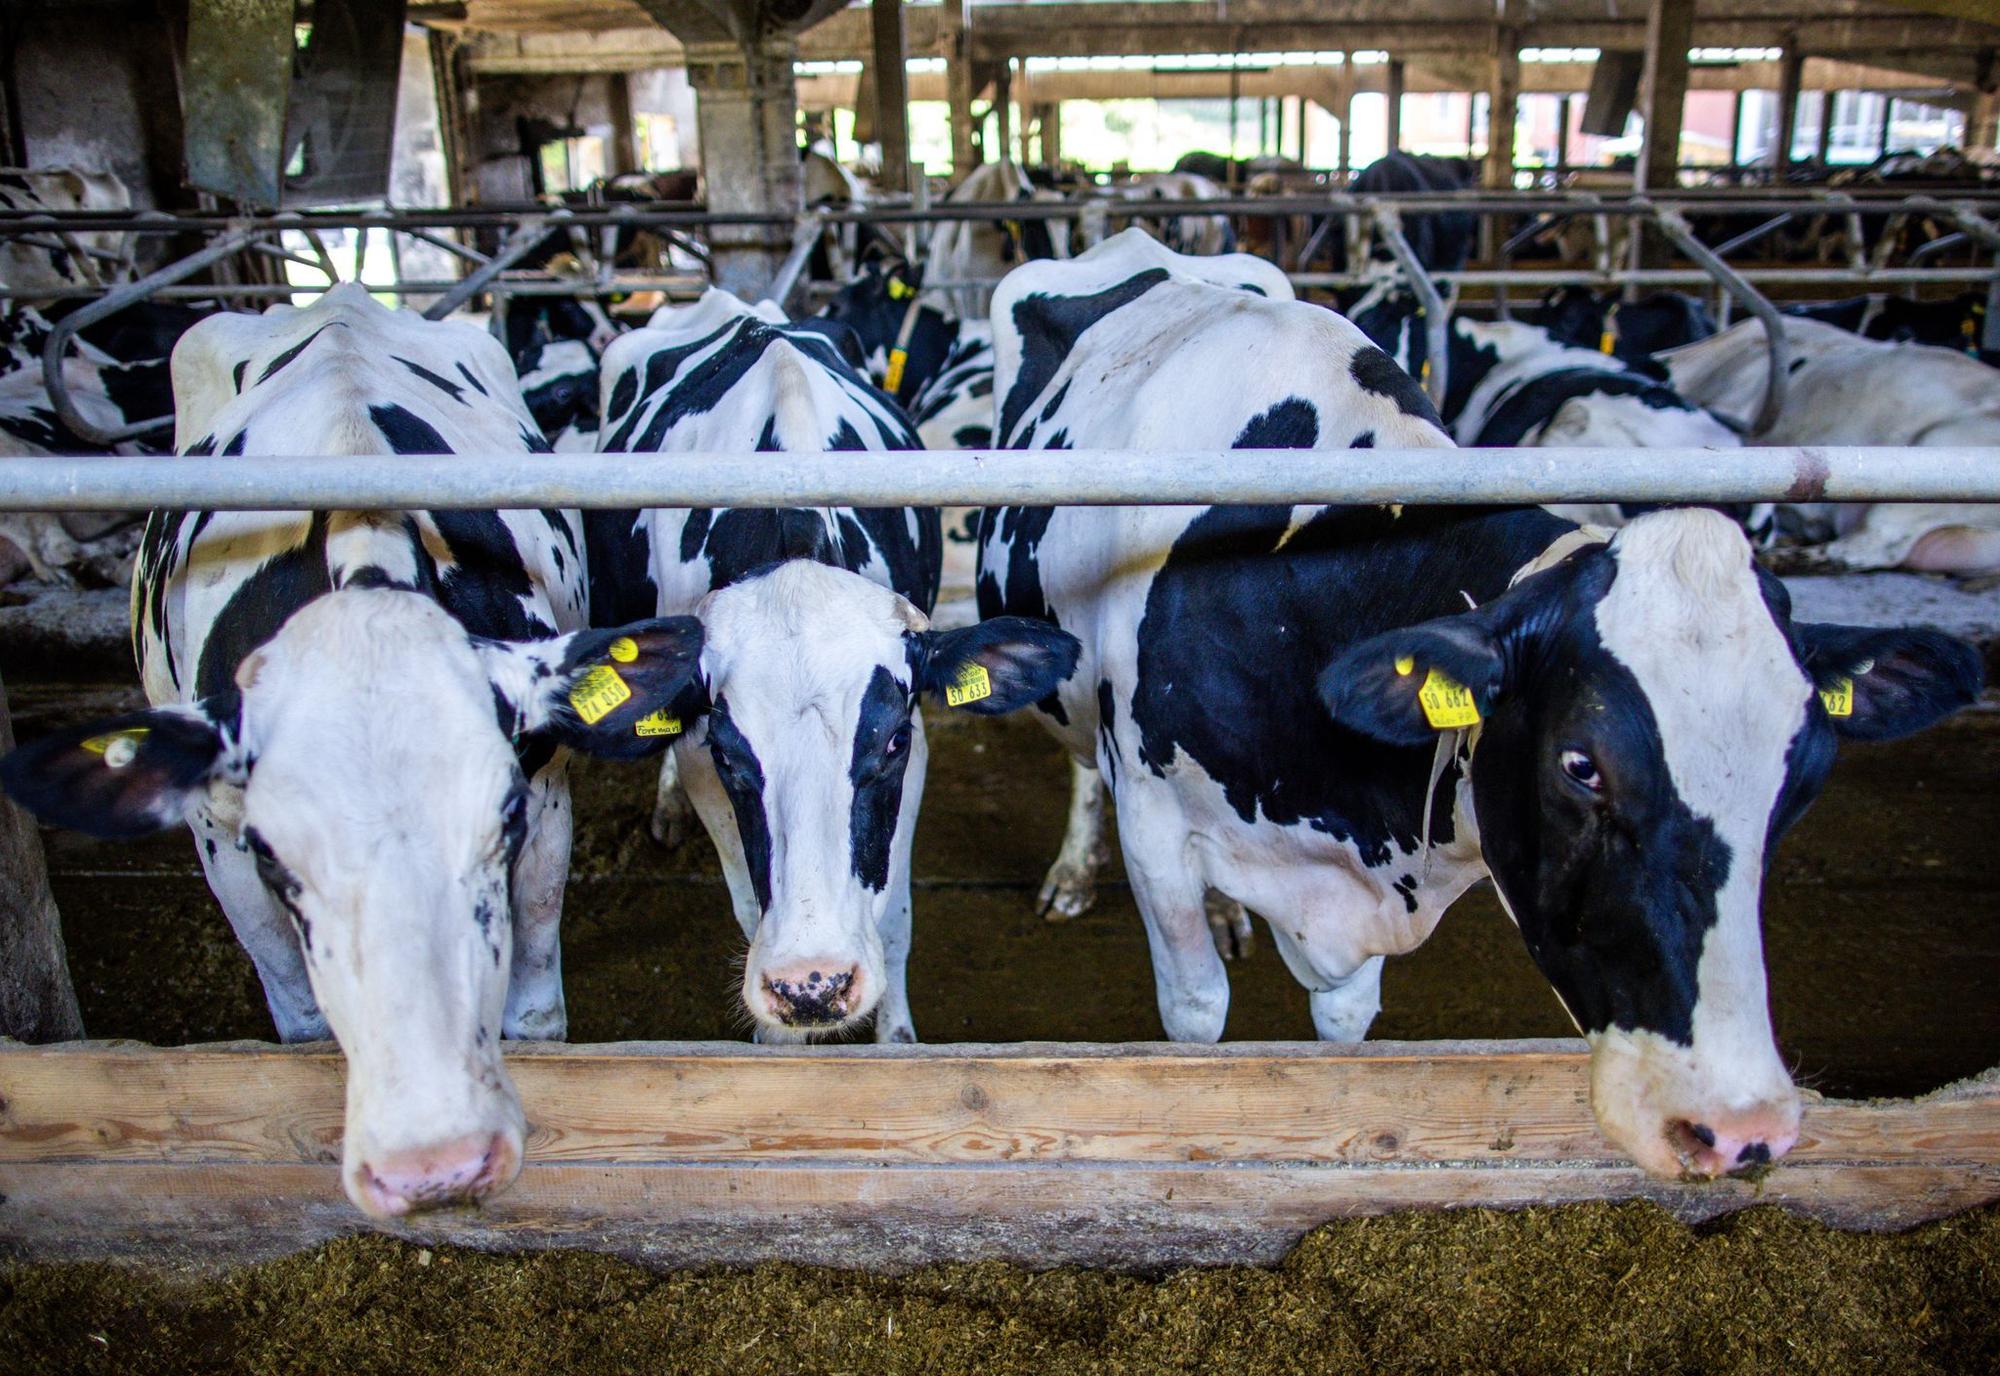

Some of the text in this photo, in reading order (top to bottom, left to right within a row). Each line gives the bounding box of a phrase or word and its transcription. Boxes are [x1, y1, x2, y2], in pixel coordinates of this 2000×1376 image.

[969, 682, 987, 699] 633
[1424, 692, 1440, 710] 50
[1825, 694, 1845, 712] 62
